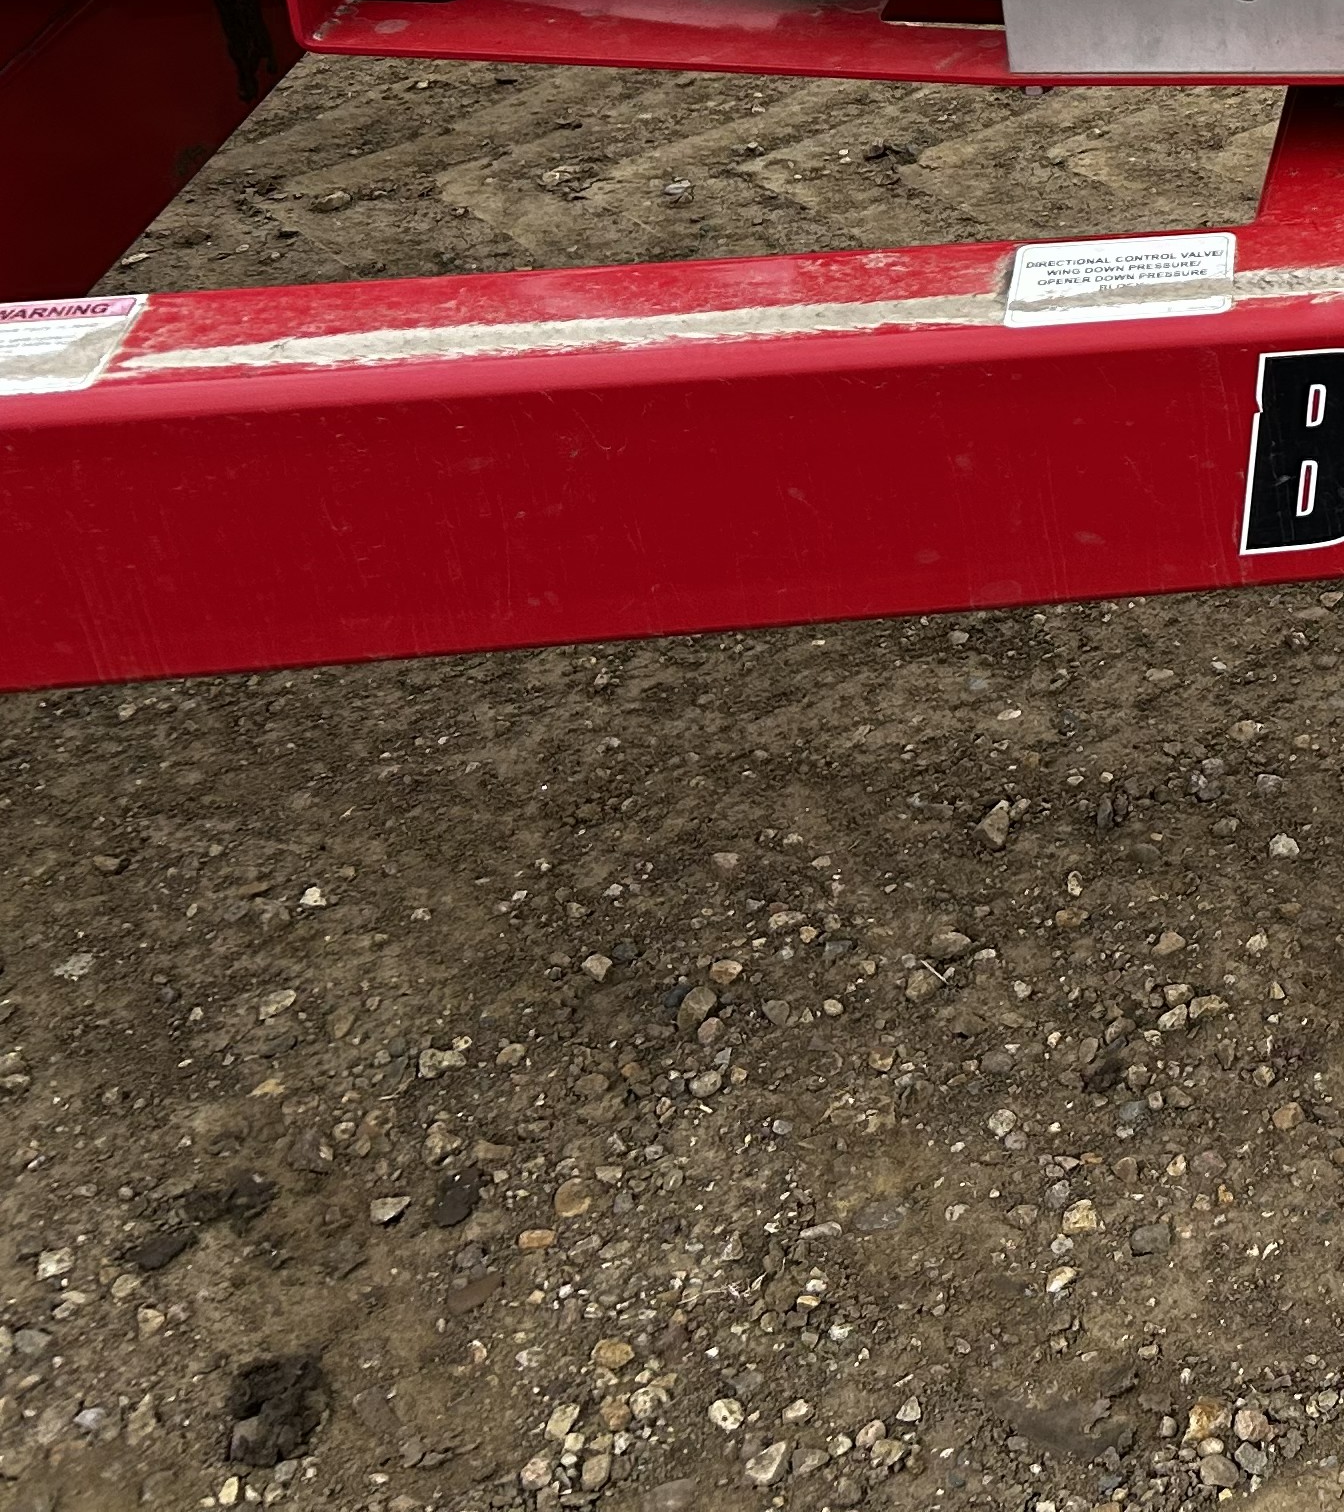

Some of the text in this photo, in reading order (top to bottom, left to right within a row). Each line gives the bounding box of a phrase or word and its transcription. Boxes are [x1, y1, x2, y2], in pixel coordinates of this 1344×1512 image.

[1026, 257, 1112, 269] DIRECTIONAL
[1115, 252, 1175, 263] CONTROL
[1037, 269, 1208, 286] OPENER DOWN PRESSURE
[1047, 267, 1081, 276] WING
[1085, 264, 1125, 274] DOWN
